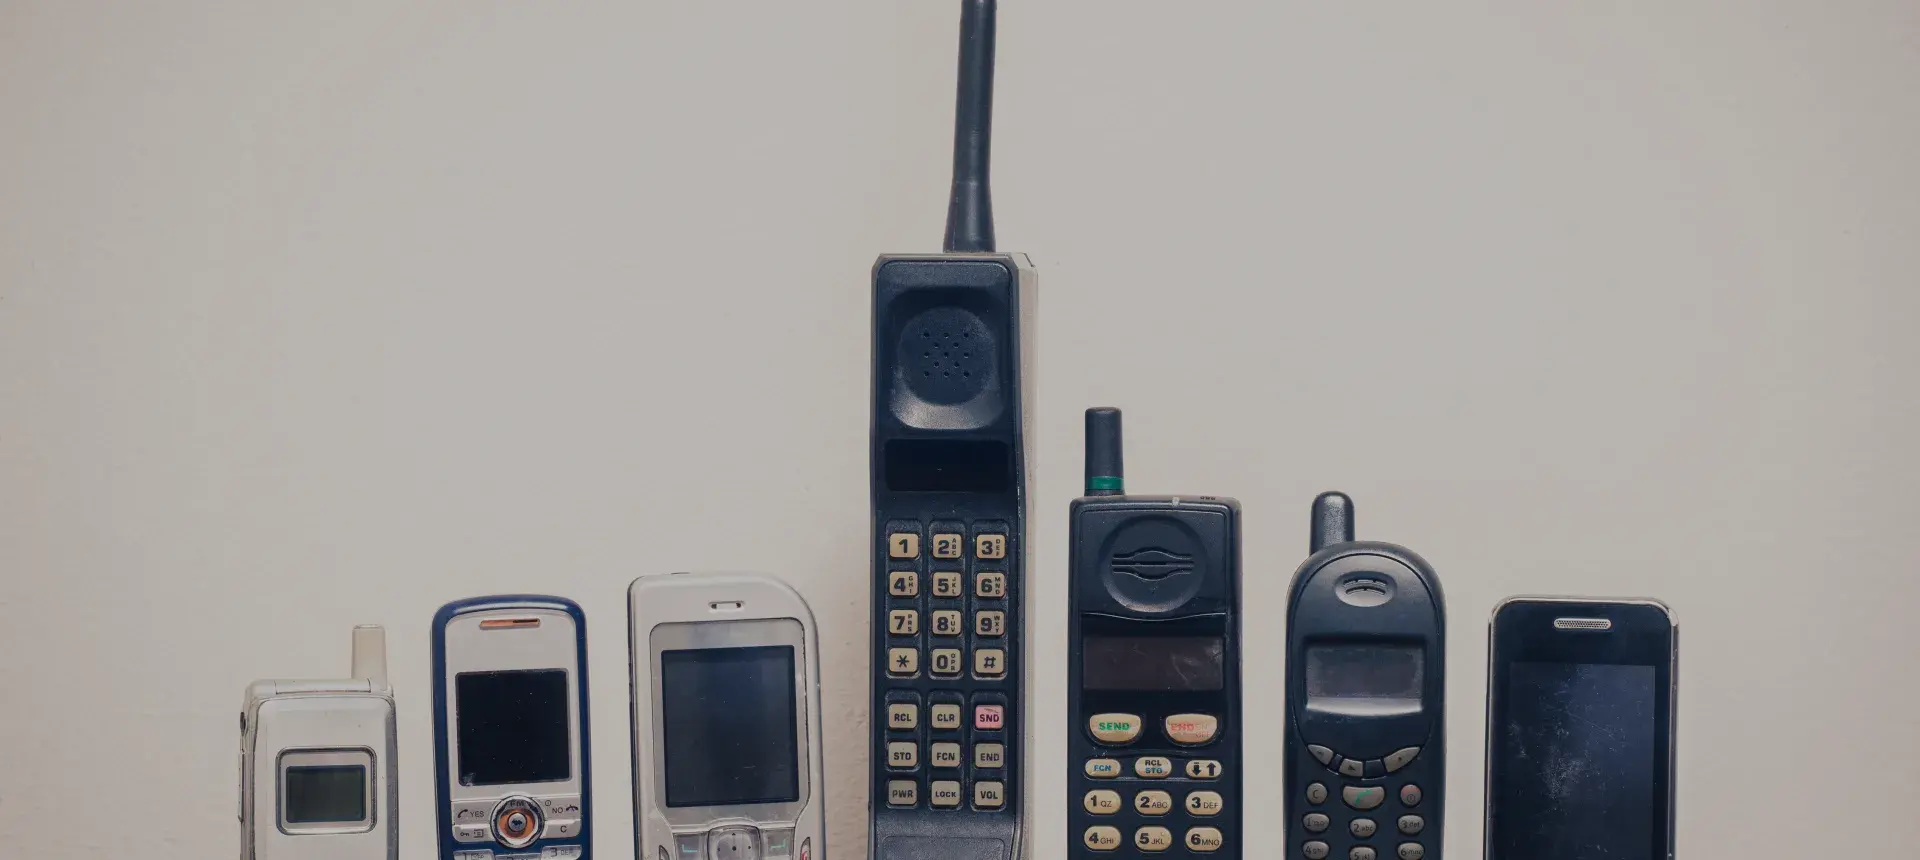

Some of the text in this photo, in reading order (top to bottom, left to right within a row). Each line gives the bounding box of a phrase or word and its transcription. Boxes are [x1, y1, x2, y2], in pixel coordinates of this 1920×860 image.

[899, 538, 908, 554] 1
[938, 540, 950, 554] 2
[982, 540, 994, 555] 3
[894, 578, 906, 592] 4
[938, 578, 949, 593] 5
[981, 578, 992, 593] 6
[894, 616, 906, 630] 7
[937, 616, 949, 632] 8
[980, 617, 992, 632] 9
[936, 654, 948, 670] 0
[894, 713, 912, 722] RCL
[937, 714, 955, 722] CLR
[980, 714, 1000, 722] SND
[1098, 722, 1131, 731] SEND
[894, 752, 912, 760] STO
[936, 752, 955, 760] FCN
[892, 790, 914, 798] PWR
[980, 791, 998, 800] VOL
[1312, 790, 1318, 799] C
[1090, 795, 1098, 806] 1
[1140, 796, 1150, 808] 2
[1192, 797, 1201, 809] 3
[1354, 824, 1360, 832] 2
[1089, 832, 1100, 844] 4
[1140, 833, 1150, 844] 5
[1190, 834, 1201, 846] 6
[550, 848, 558, 857] 3
